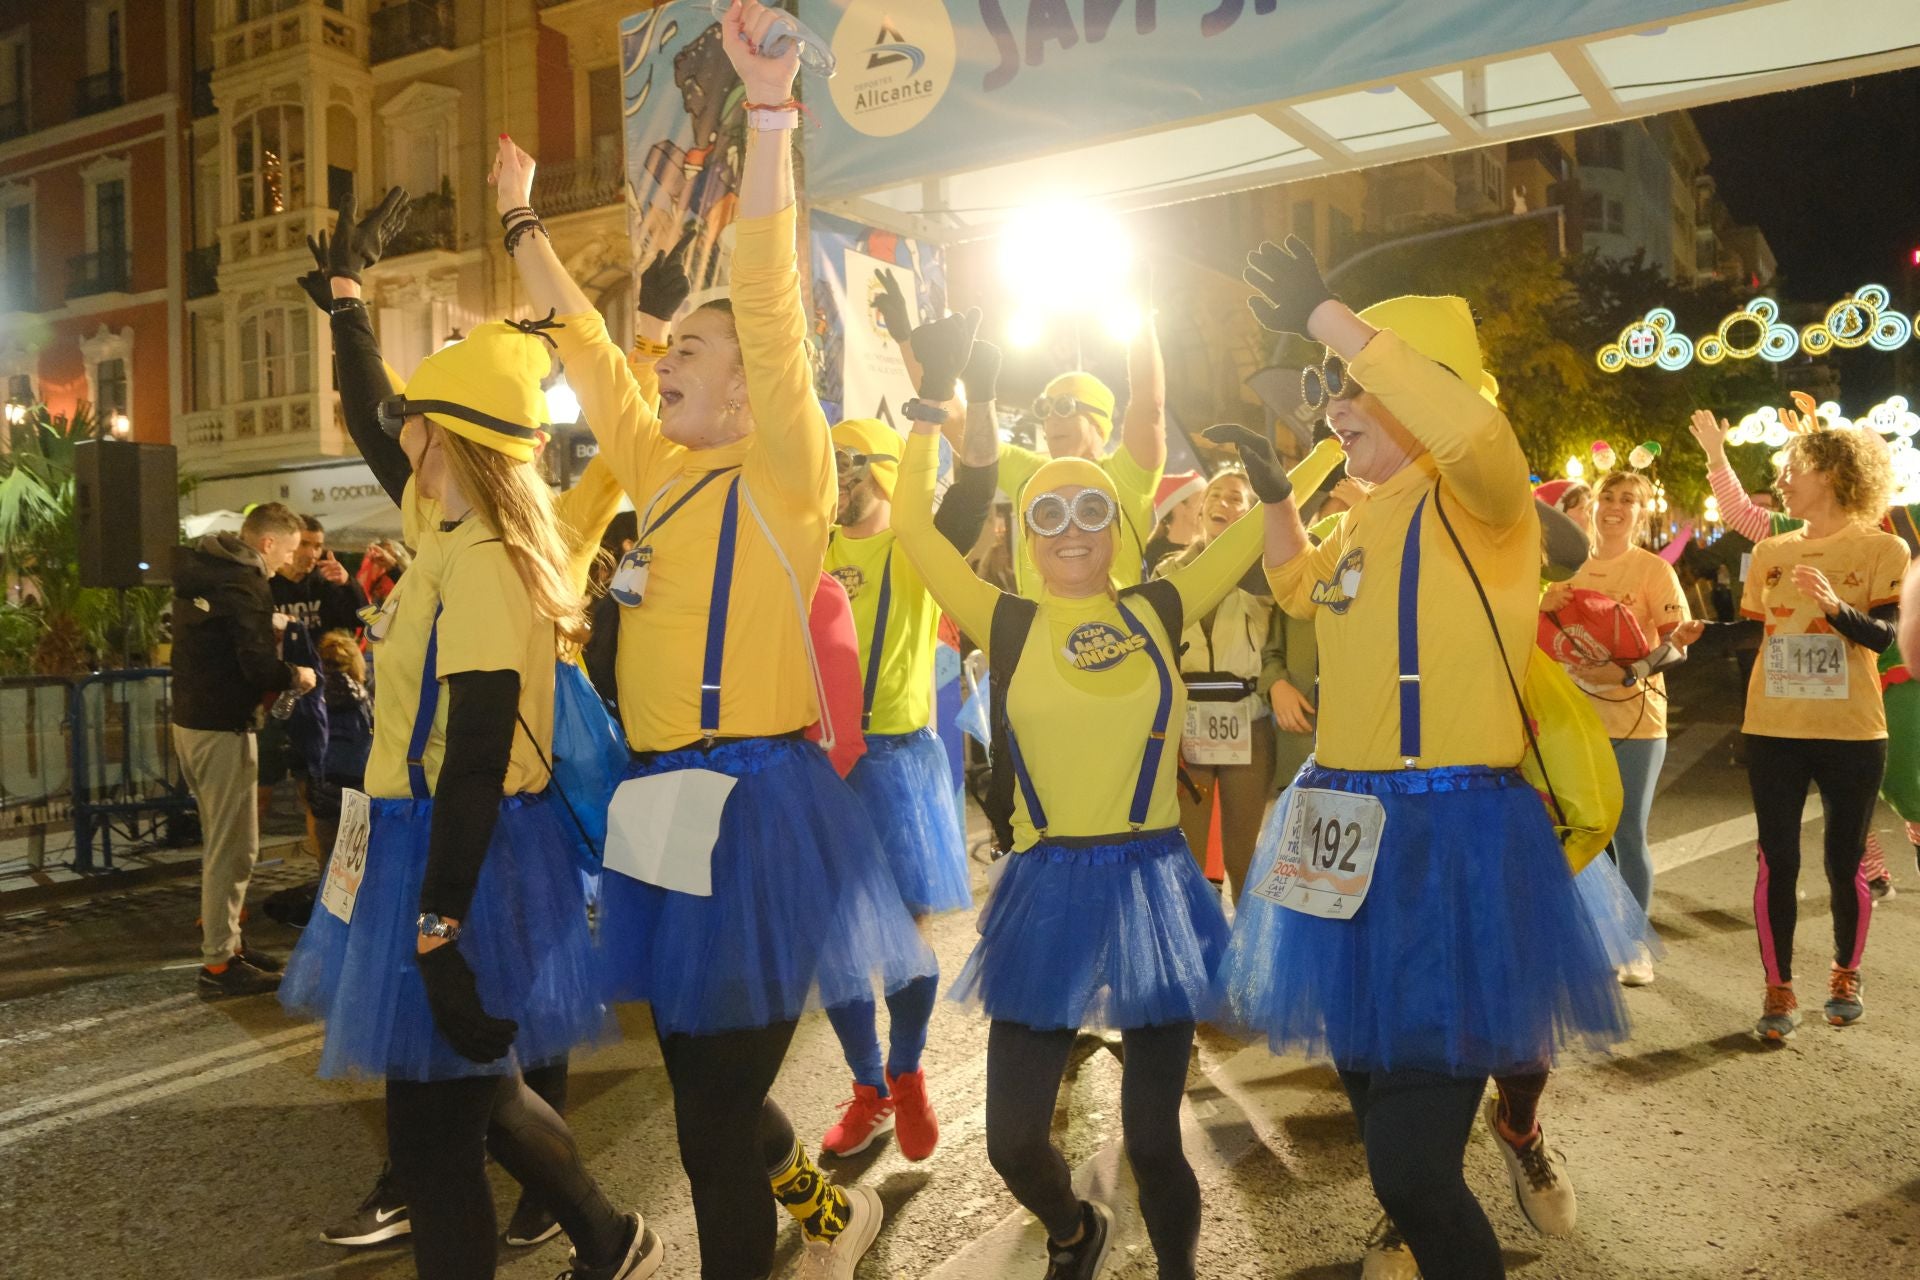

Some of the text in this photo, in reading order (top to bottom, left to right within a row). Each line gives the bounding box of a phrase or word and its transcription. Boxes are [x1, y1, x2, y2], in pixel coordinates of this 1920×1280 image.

[855, 80, 933, 110] Alicante
[1076, 626, 1105, 639] TEAM
[1070, 634, 1146, 669] INIONS
[1793, 647, 1840, 674] 1124
[1208, 715, 1239, 740] 850
[1310, 816, 1362, 873] 192
